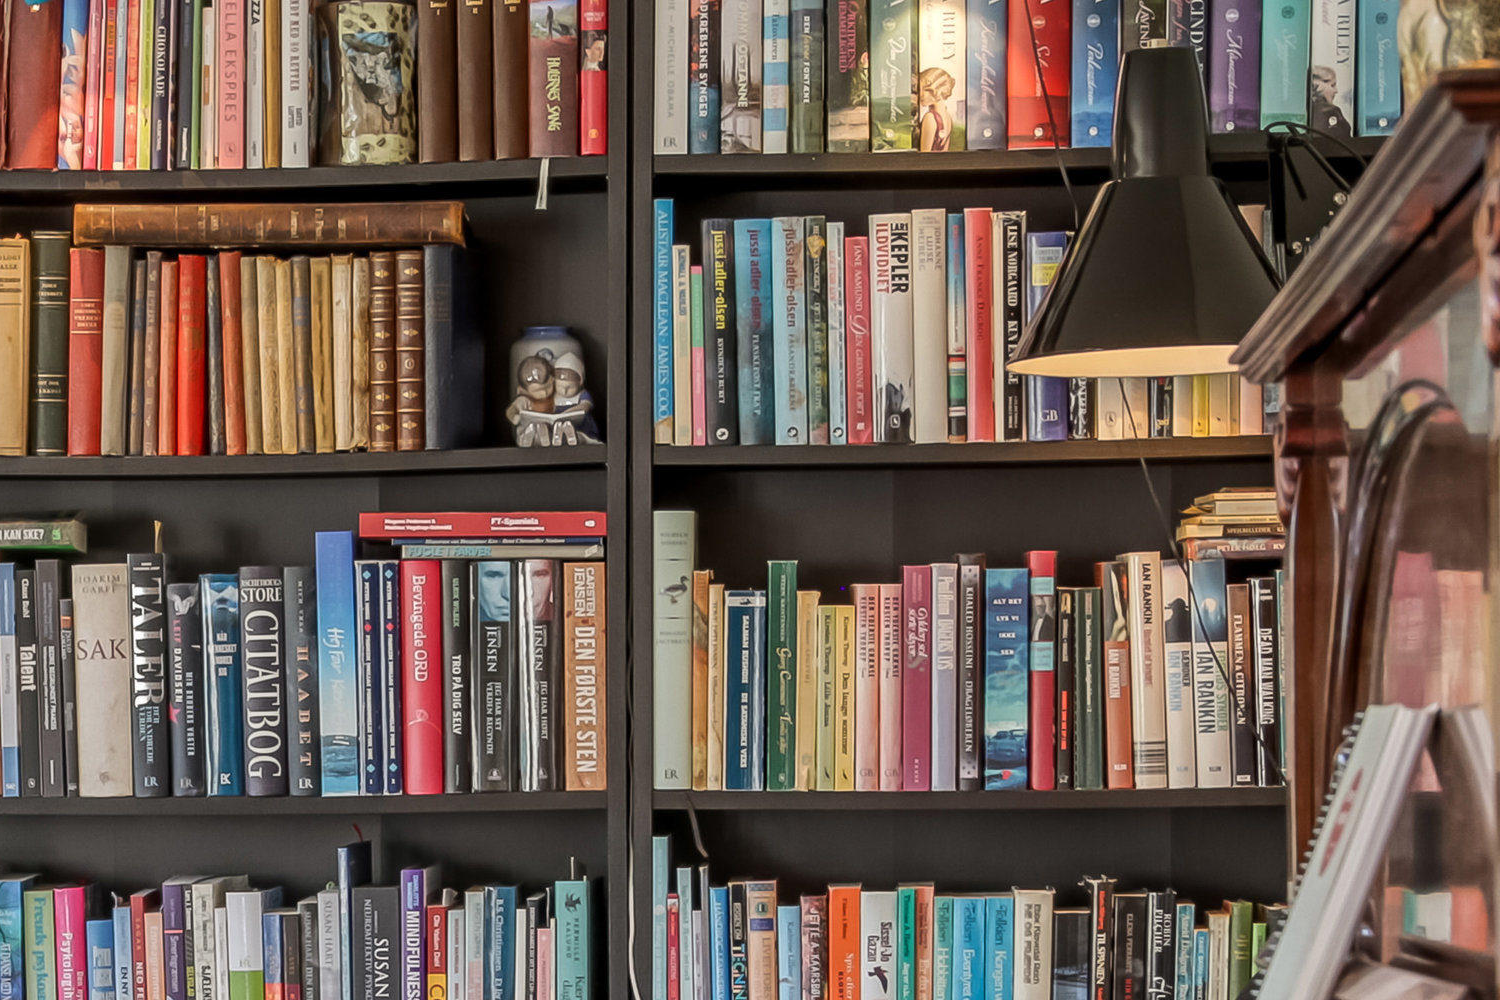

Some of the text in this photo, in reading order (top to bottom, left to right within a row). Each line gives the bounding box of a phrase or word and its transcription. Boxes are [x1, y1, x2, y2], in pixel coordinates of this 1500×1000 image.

[156, 26, 167, 97] CHOKOLADE
[1336, 15, 1350, 64] RILEY
[545, 57, 561, 131] HULERNES SANG
[667, 25, 675, 118] MICHELLE OBAMA
[711, 230, 726, 258] jussi
[853, 245, 862, 266] JANE
[876, 223, 889, 293] ILDVIDNET
[1007, 225, 1017, 248] LISE
[891, 232, 909, 293] KEPLER
[1007, 251, 1018, 306] NØRGAARD
[715, 261, 727, 329] adler-olsen
[4, 529, 21, 540] KAN
[23, 528, 44, 540] SKE?
[21, 578, 30, 618] Claus Buhl
[240, 588, 283, 602] STORE
[574, 567, 585, 617] JENSEN
[585, 567, 595, 617] CARSTEN
[1142, 563, 1152, 624] IAN RANKIN
[77, 639, 127, 660] SAK
[131, 577, 164, 707] TALER
[410, 575, 428, 682] Bevingede ORD
[485, 626, 498, 672] JENSEN
[20, 644, 36, 692] Talent
[173, 619, 183, 703] LEIF DAVIDSEN
[451, 655, 462, 675] TRO
[451, 677, 463, 690] PÅ
[964, 587, 975, 752] KHALED HOSSEINI DRAGELØBEREN
[1259, 628, 1274, 724] DEAD MAN WALKING
[244, 610, 282, 778] CITATBOG
[296, 646, 312, 766] HAABET
[452, 692, 461, 708] DIG
[575, 626, 597, 772] DEN FØRSTE STEN
[1197, 650, 1216, 733] IAN RANKIN
[452, 711, 462, 735] SELV
[33, 897, 47, 946] Freuds
[363, 899, 372, 972] NEUROAFFEKTIV
[495, 899, 504, 971] B.S. Christiansen
[565, 921, 573, 958] AALUND
[937, 902, 948, 943] Tolkien
[1153, 909, 1164, 952] PILCHER
[1163, 913, 1171, 946] ROBIN
[135, 962, 144, 984] NEO
[374, 938, 389, 996] SUSAN
[809, 908, 821, 1000] JETTE A. KAARSBØL
[867, 936, 879, 962] Gazan
